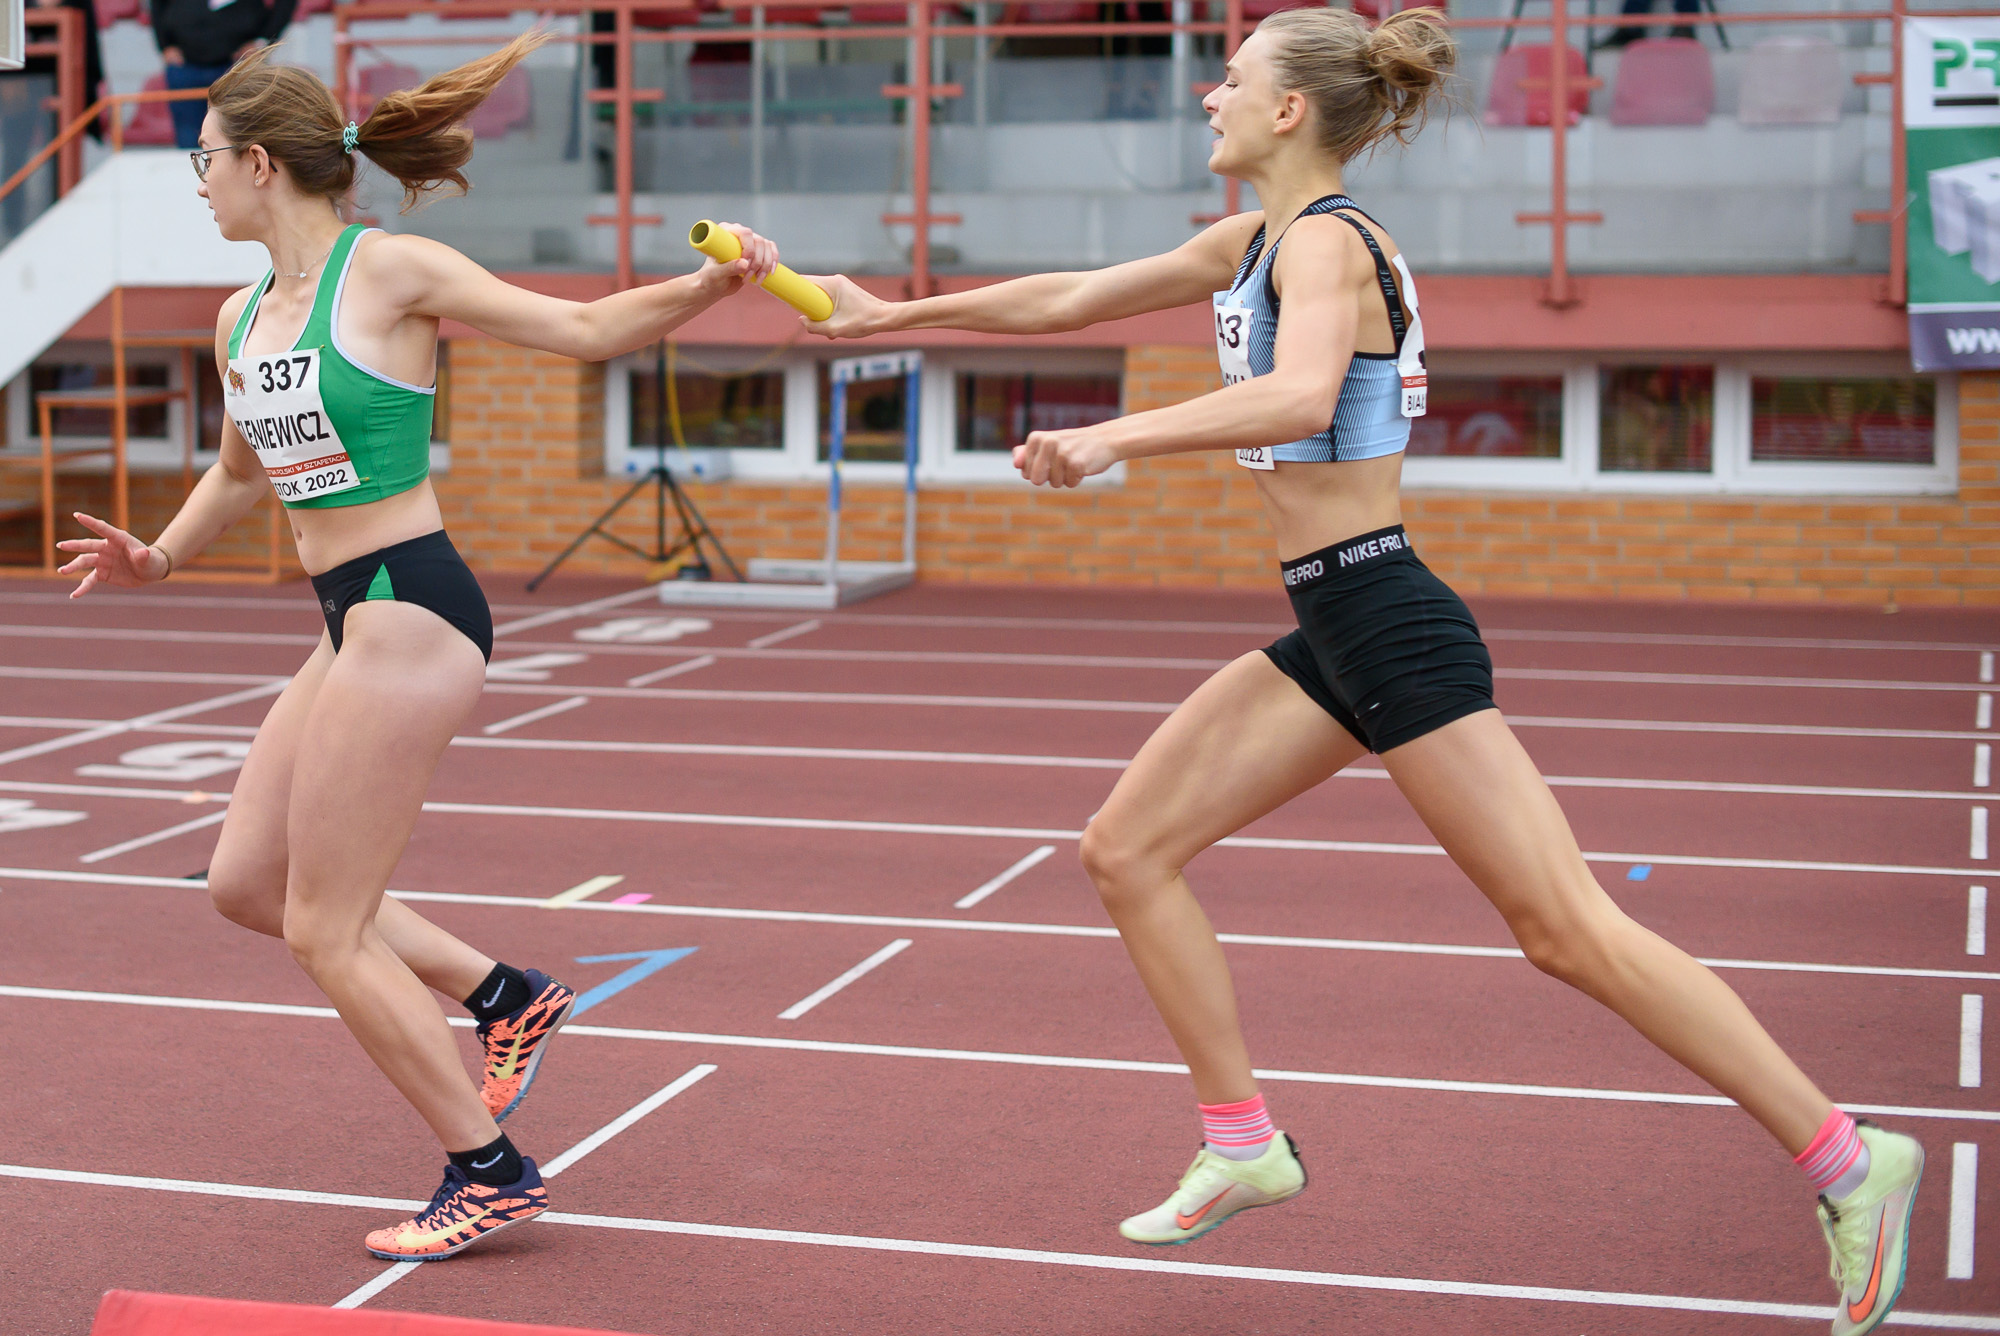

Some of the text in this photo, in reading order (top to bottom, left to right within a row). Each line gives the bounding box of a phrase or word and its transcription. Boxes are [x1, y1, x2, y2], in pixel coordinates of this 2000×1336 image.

[1359, 228, 1381, 253] NIKE
[1379, 269, 1397, 296] NIKE
[258, 356, 311, 393] 337
[295, 464, 303, 472] W
[303, 455, 346, 470] SZTAFETACH
[305, 469, 348, 492] 2022
[1296, 559, 1324, 583] PRO
[1338, 540, 1381, 568] NIKE
[1379, 534, 1403, 553] PRO
